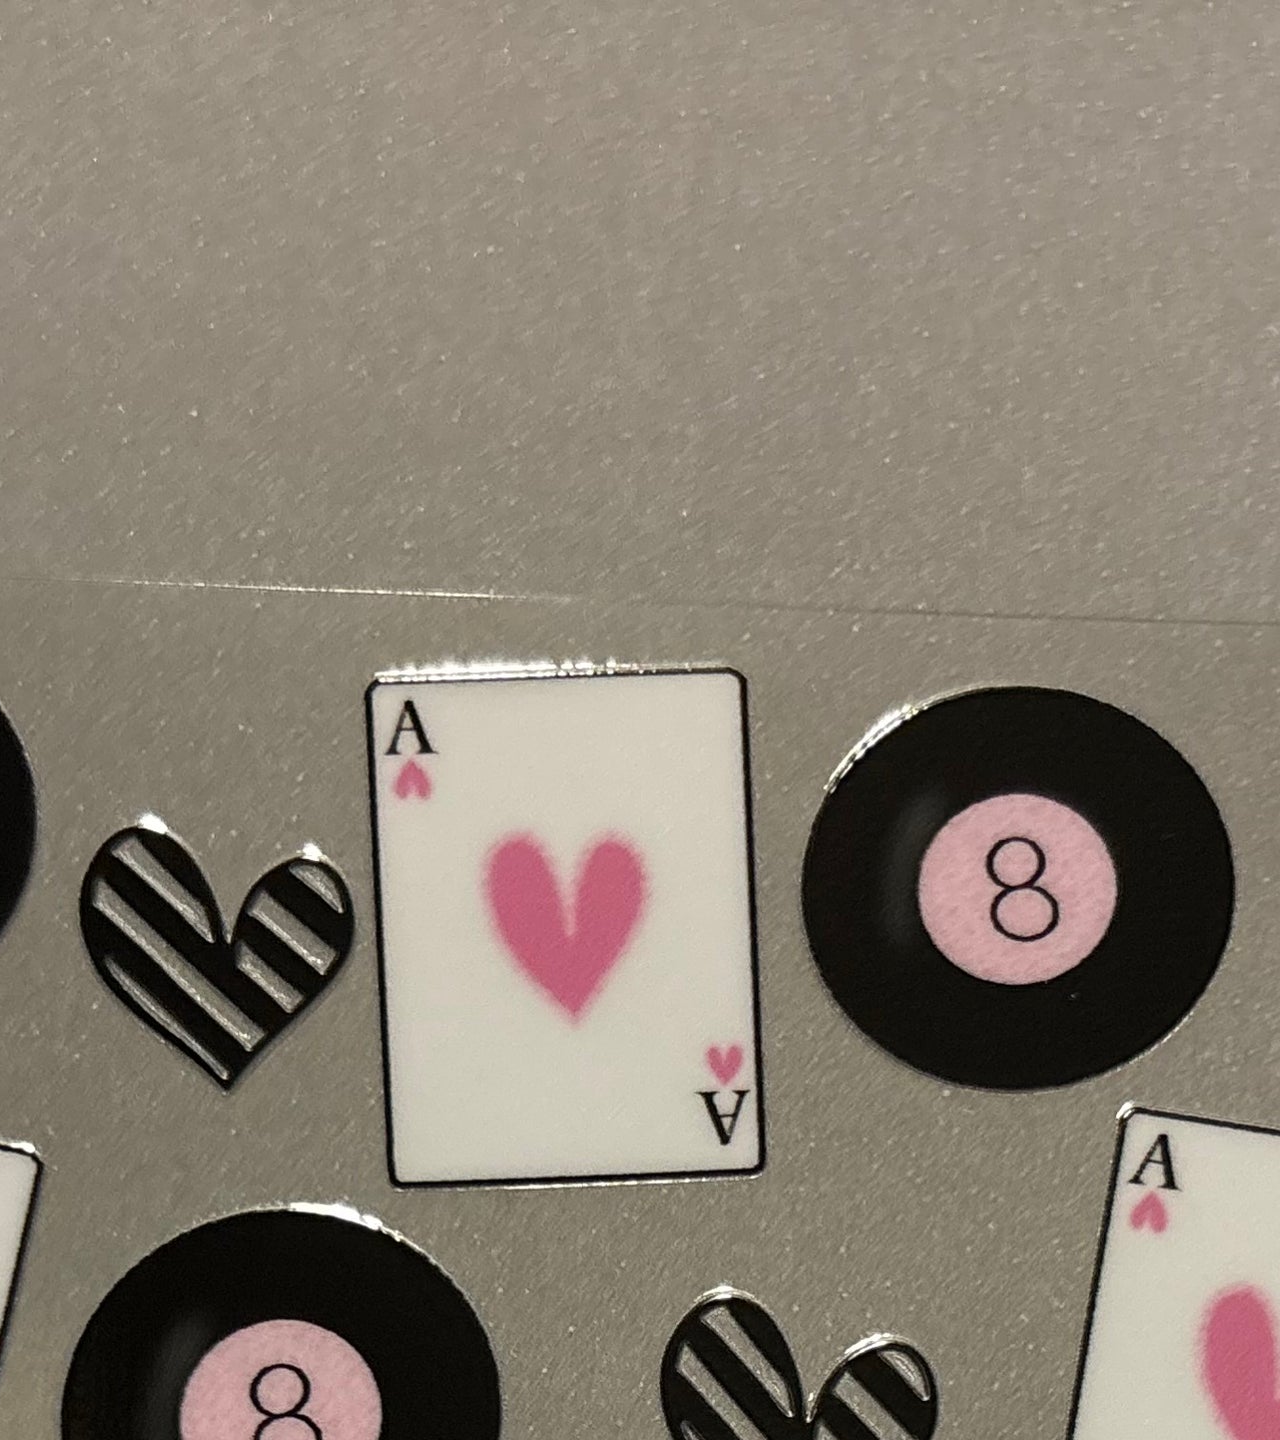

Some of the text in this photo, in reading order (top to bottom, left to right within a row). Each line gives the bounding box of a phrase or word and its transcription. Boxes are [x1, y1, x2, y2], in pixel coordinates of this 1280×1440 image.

[386, 700, 435, 755] A
[985, 836, 1060, 942] 8
[698, 1090, 750, 1145] A
[1129, 1134, 1178, 1190] A
